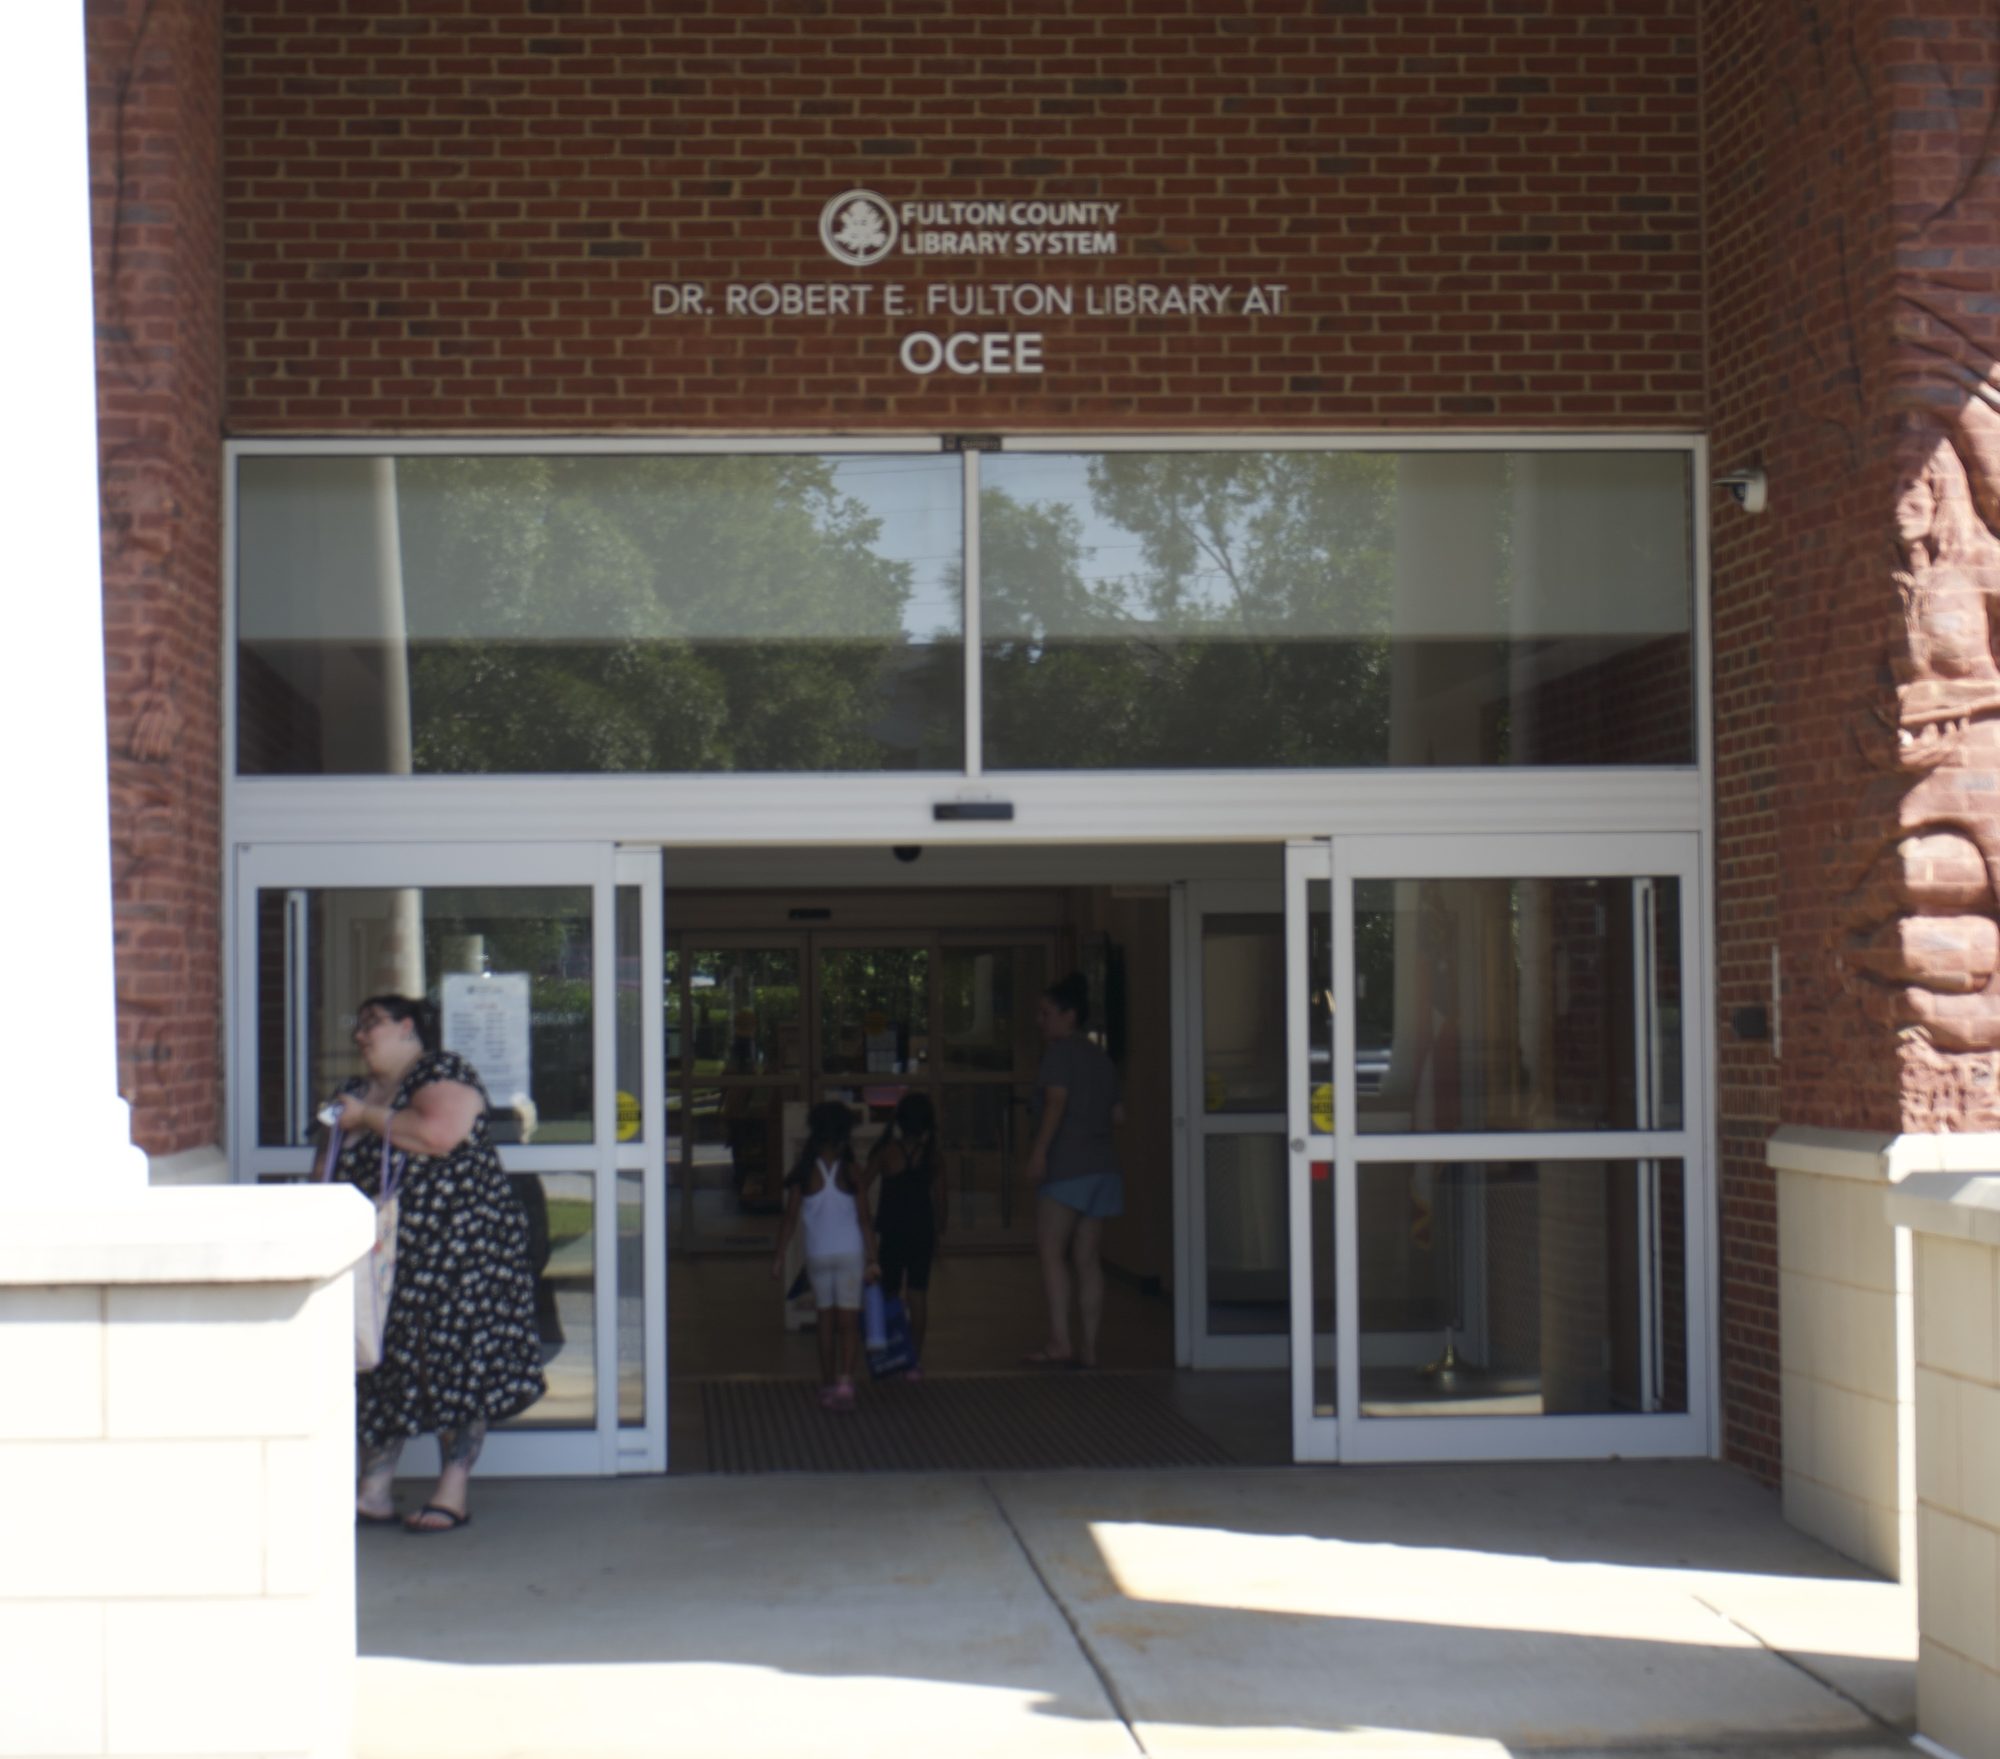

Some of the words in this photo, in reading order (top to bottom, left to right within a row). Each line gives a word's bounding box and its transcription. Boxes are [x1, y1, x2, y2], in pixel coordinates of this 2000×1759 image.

[901, 202, 1006, 226] FULTON
[1009, 202, 1120, 226] COUNTY
[901, 231, 1011, 255] LIBRARY
[1014, 231, 1118, 255] SYSTEM
[653, 283, 714, 315] DR.
[725, 283, 873, 316] ROBERT
[883, 284, 914, 316] E.
[927, 283, 1074, 316] FULTON
[1085, 284, 1232, 316] LIBRARY
[1241, 284, 1287, 316] AT
[899, 330, 1045, 375] OCEE
